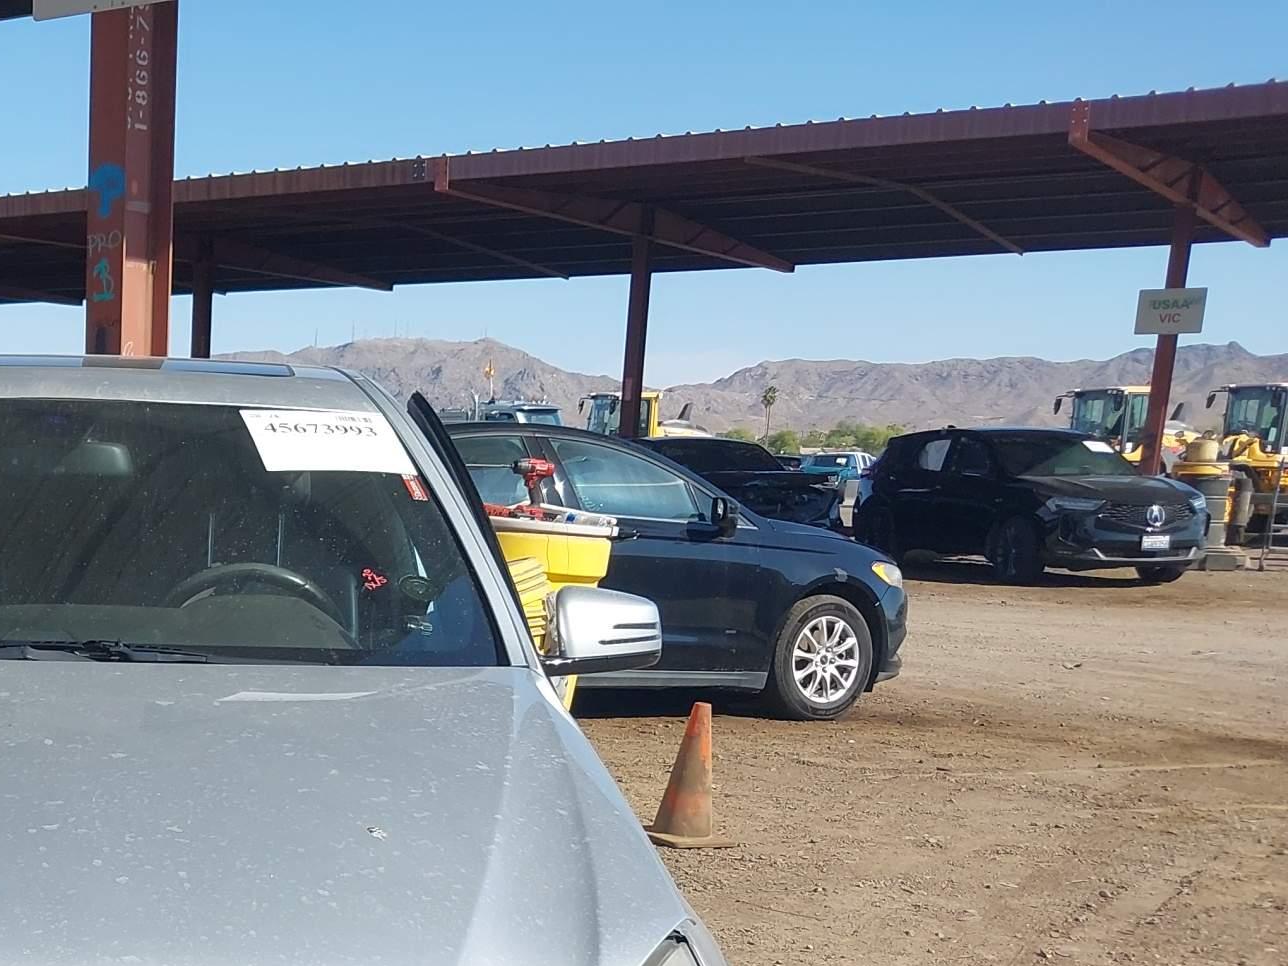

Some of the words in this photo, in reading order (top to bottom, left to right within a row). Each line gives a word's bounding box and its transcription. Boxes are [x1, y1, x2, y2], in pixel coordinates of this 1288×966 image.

[134, 4, 153, 131] 1-866-7
[1159, 312, 1182, 324] VIC
[264, 422, 379, 437] 45673993
